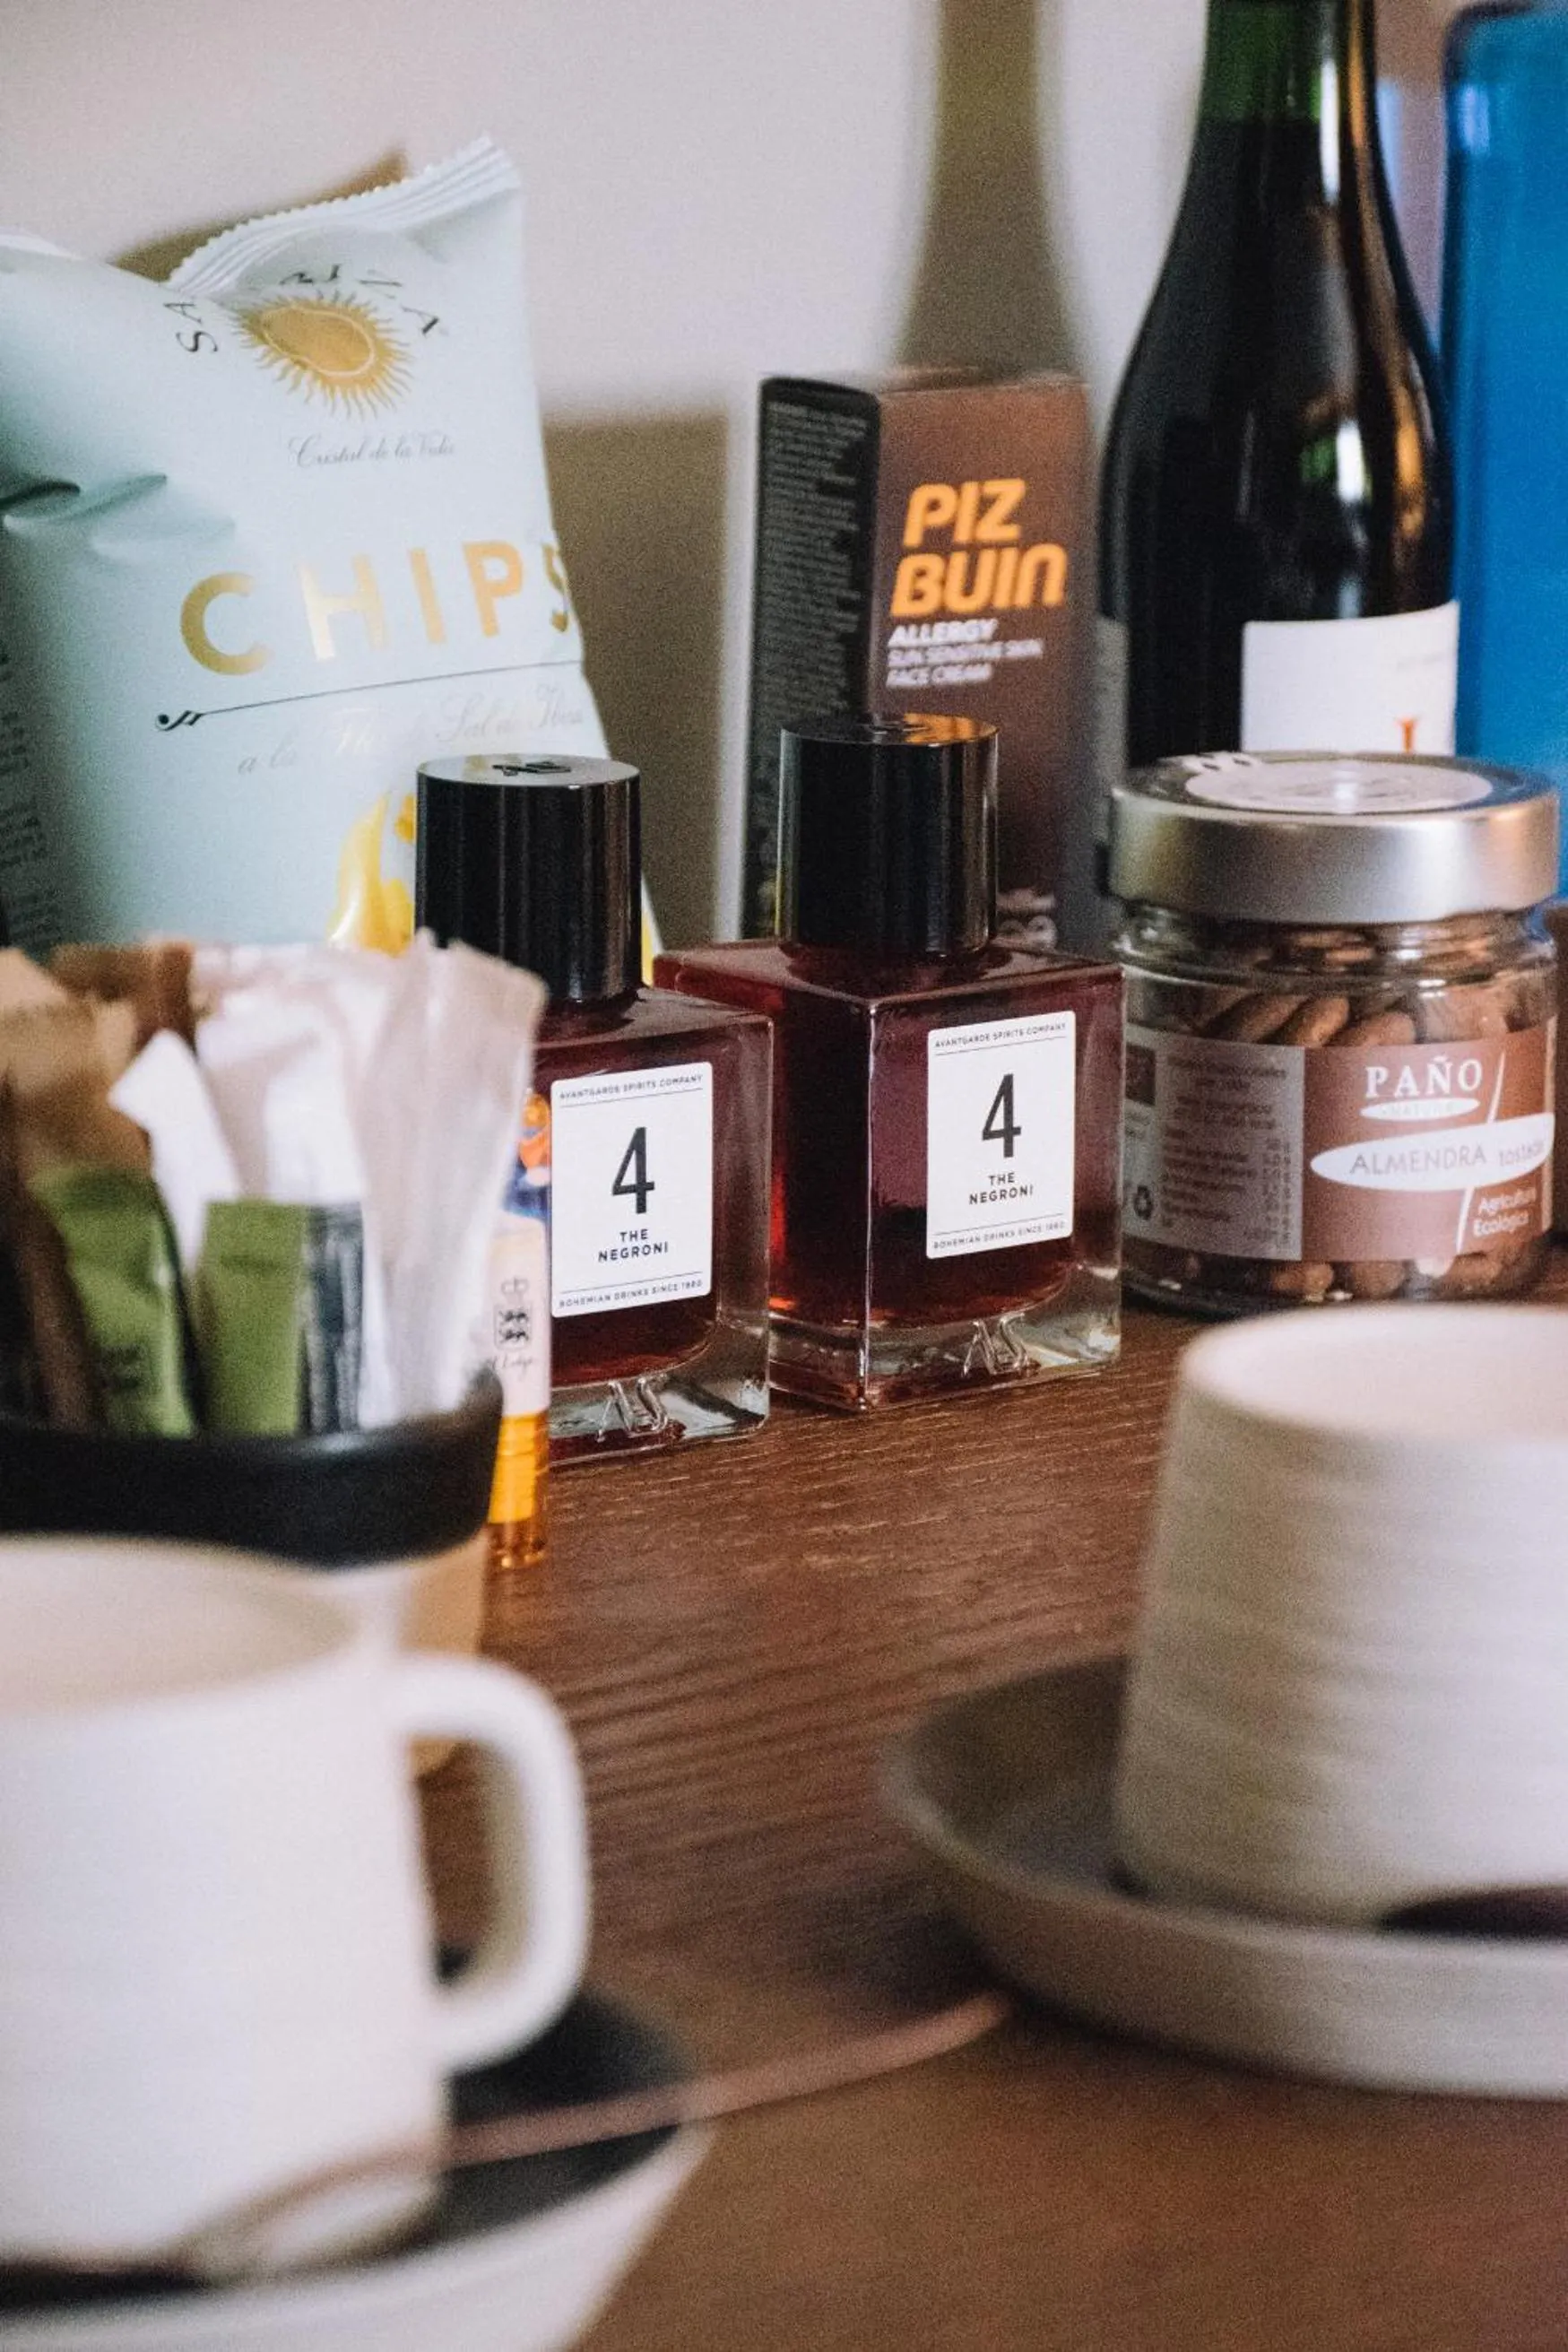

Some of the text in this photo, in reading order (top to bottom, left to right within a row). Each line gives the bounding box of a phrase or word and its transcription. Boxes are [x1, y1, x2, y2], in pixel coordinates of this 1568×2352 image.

[903, 478, 1028, 549] PIZ
[1364, 1055, 1483, 1099] PAÑO
[982, 1073, 1022, 1159] 4
[611, 1126, 655, 1214] 4
[1349, 1144, 1488, 1175] ALMENDRA
[989, 1172, 1015, 1185] THE
[968, 1185, 1034, 1205] NEGRONI
[620, 1228, 649, 1244] THE
[598, 1241, 670, 1263] NEGRONI
